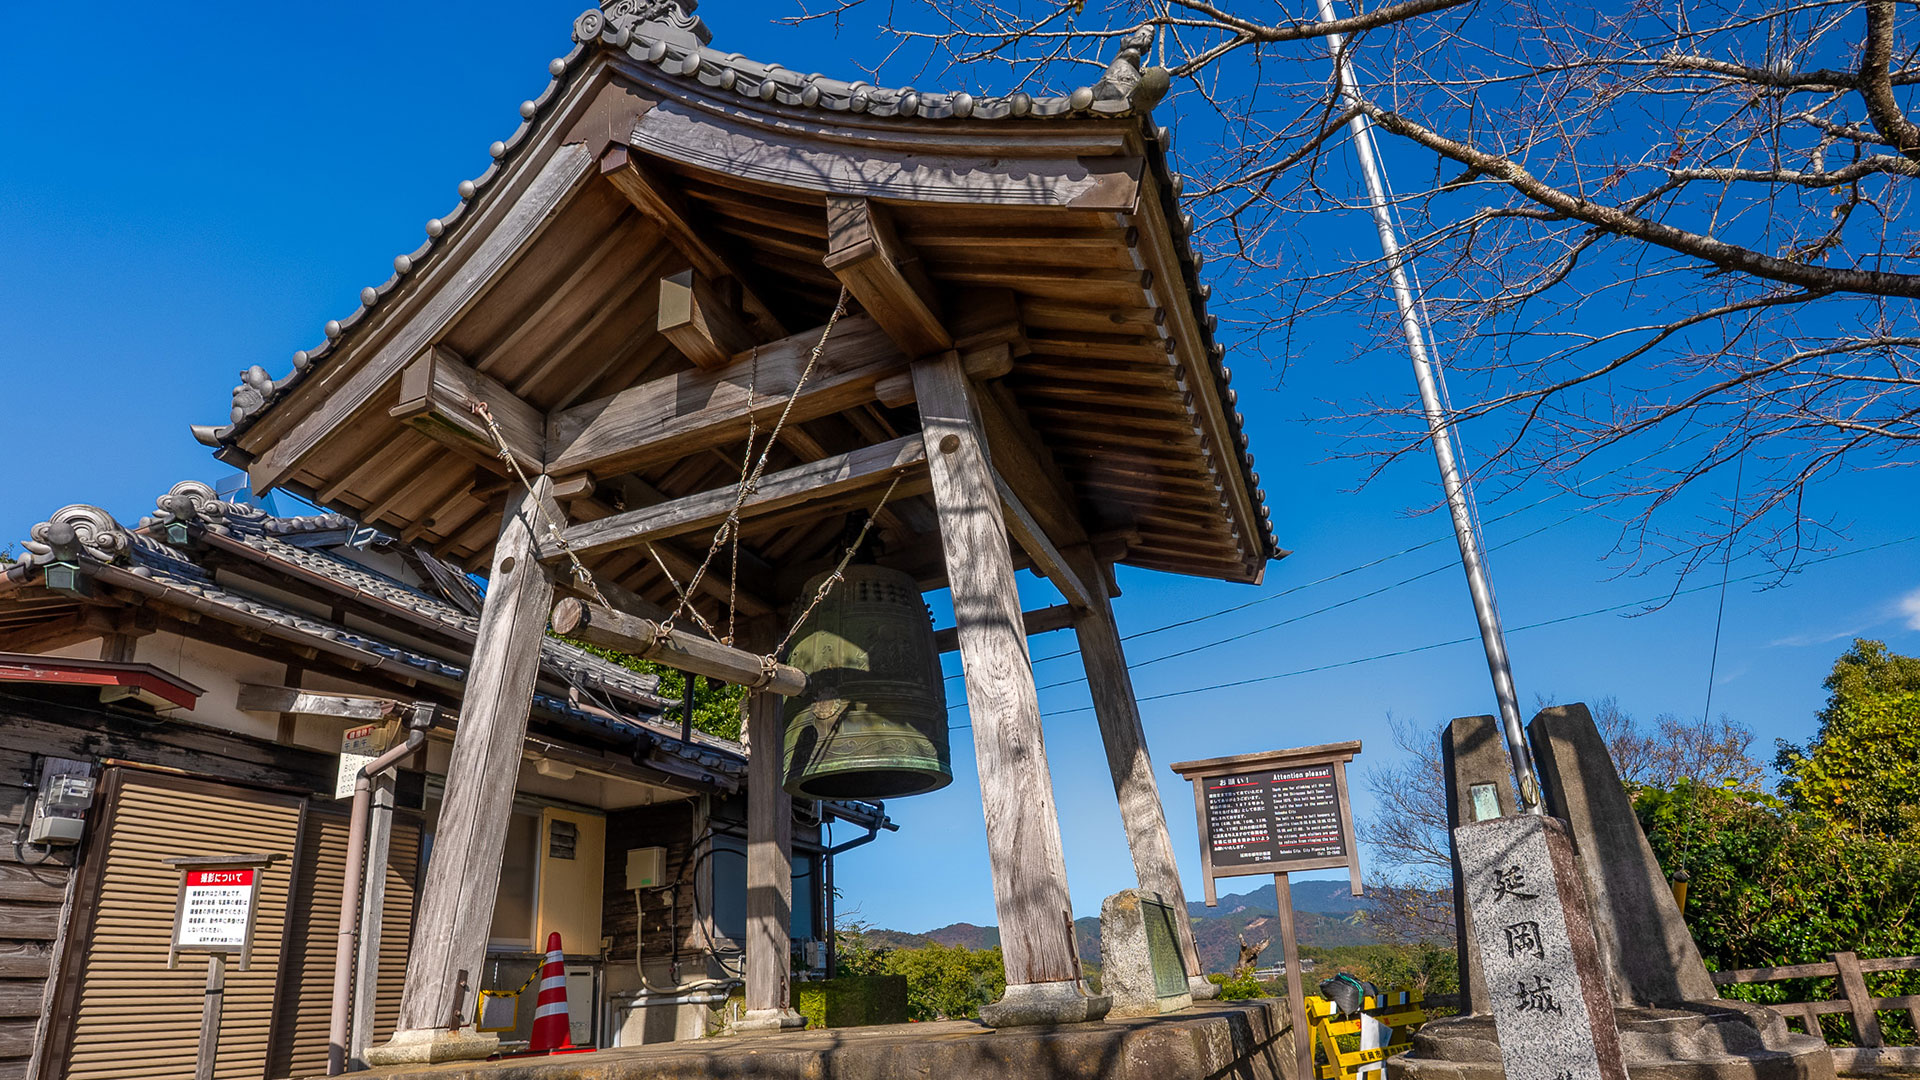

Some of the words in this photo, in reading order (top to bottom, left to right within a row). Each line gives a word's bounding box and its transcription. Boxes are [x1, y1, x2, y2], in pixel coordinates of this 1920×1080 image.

[1273, 772, 1303, 780] Attention
[1305, 769, 1329, 778] please!
[200, 873, 243, 883] 撮影について
[1492, 864, 1562, 1017] 延岡城
